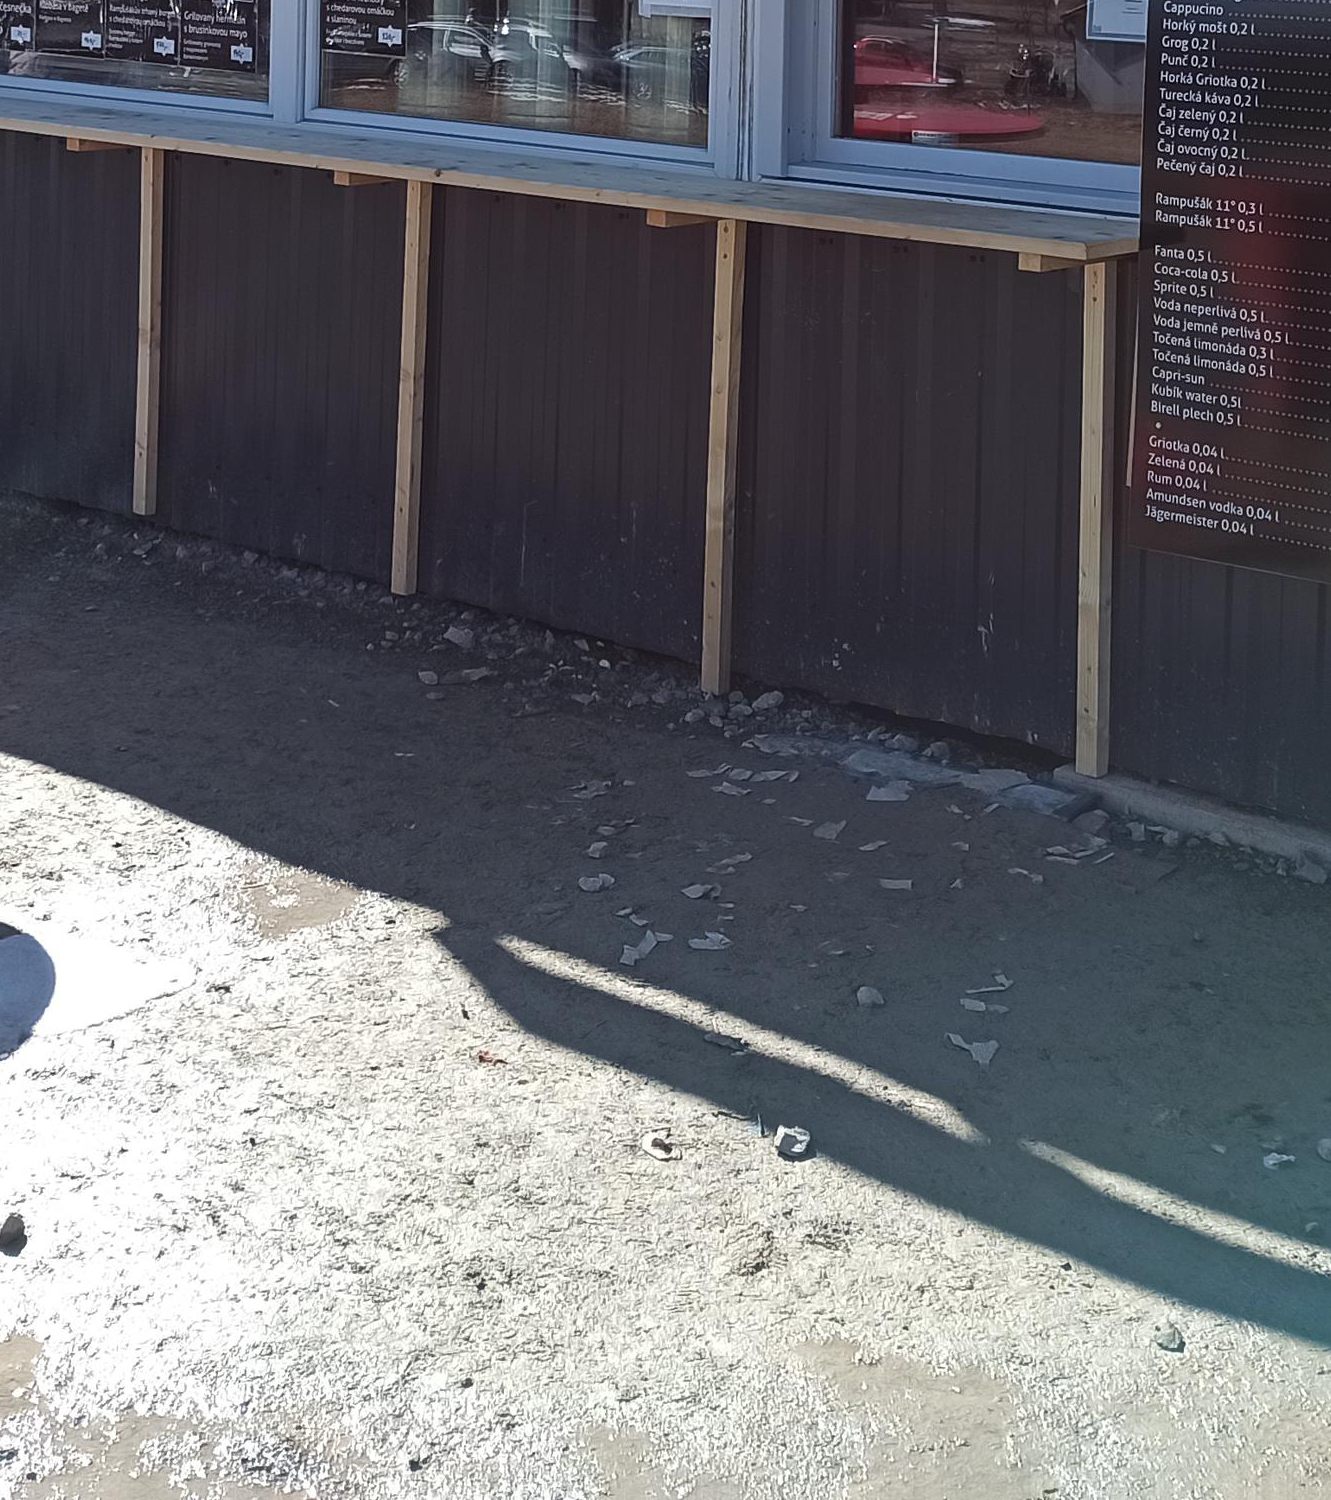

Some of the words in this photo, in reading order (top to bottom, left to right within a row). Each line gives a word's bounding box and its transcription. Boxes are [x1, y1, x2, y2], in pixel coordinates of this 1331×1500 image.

[1163, 0, 1223, 16] Cappucino
[1162, 18, 1196, 34] Horký
[1198, 21, 1227, 33] mošt
[1229, 22, 1247, 35] 0,2
[1250, 23, 1255, 35] l
[1161, 35, 1189, 51] Grog
[1191, 37, 1208, 50] 0,2
[1211, 38, 1215, 50] l
[1160, 70, 1193, 84] Horká
[1195, 73, 1237, 87] Griotka
[1240, 76, 1258, 90] 0,2
[1261, 78, 1265, 89] l
[1155, 192, 1212, 209] Rampušák
[1216, 199, 1236, 211] 11°
[1237, 201, 1255, 215] 0,3
[1259, 203, 1263, 215] l
[1154, 244, 1184, 259] Fanta
[1186, 248, 1204, 262] 0,5
[1207, 251, 1212, 263] l
[1154, 262, 1208, 279] Coca-cola
[1210, 269, 1228, 283] 0,5
[1231, 271, 1236, 283] l
[1153, 313, 1180, 328] Voda
[1182, 318, 1218, 334] jemně
[1221, 326, 1261, 340] perlivá
[1263, 329, 1281, 343] 0,5
[1285, 332, 1290, 344] l
[1152, 366, 1205, 384] Capri-sun
[1146, 488, 1206, 508] Amundsen
[1209, 501, 1243, 515] vodka
[1246, 505, 1272, 520] 0,04
[1275, 510, 1279, 522] l
[1145, 505, 1219, 528] Jägermeister
[1221, 518, 1247, 534] 0,04
[1250, 523, 1253, 535] l
